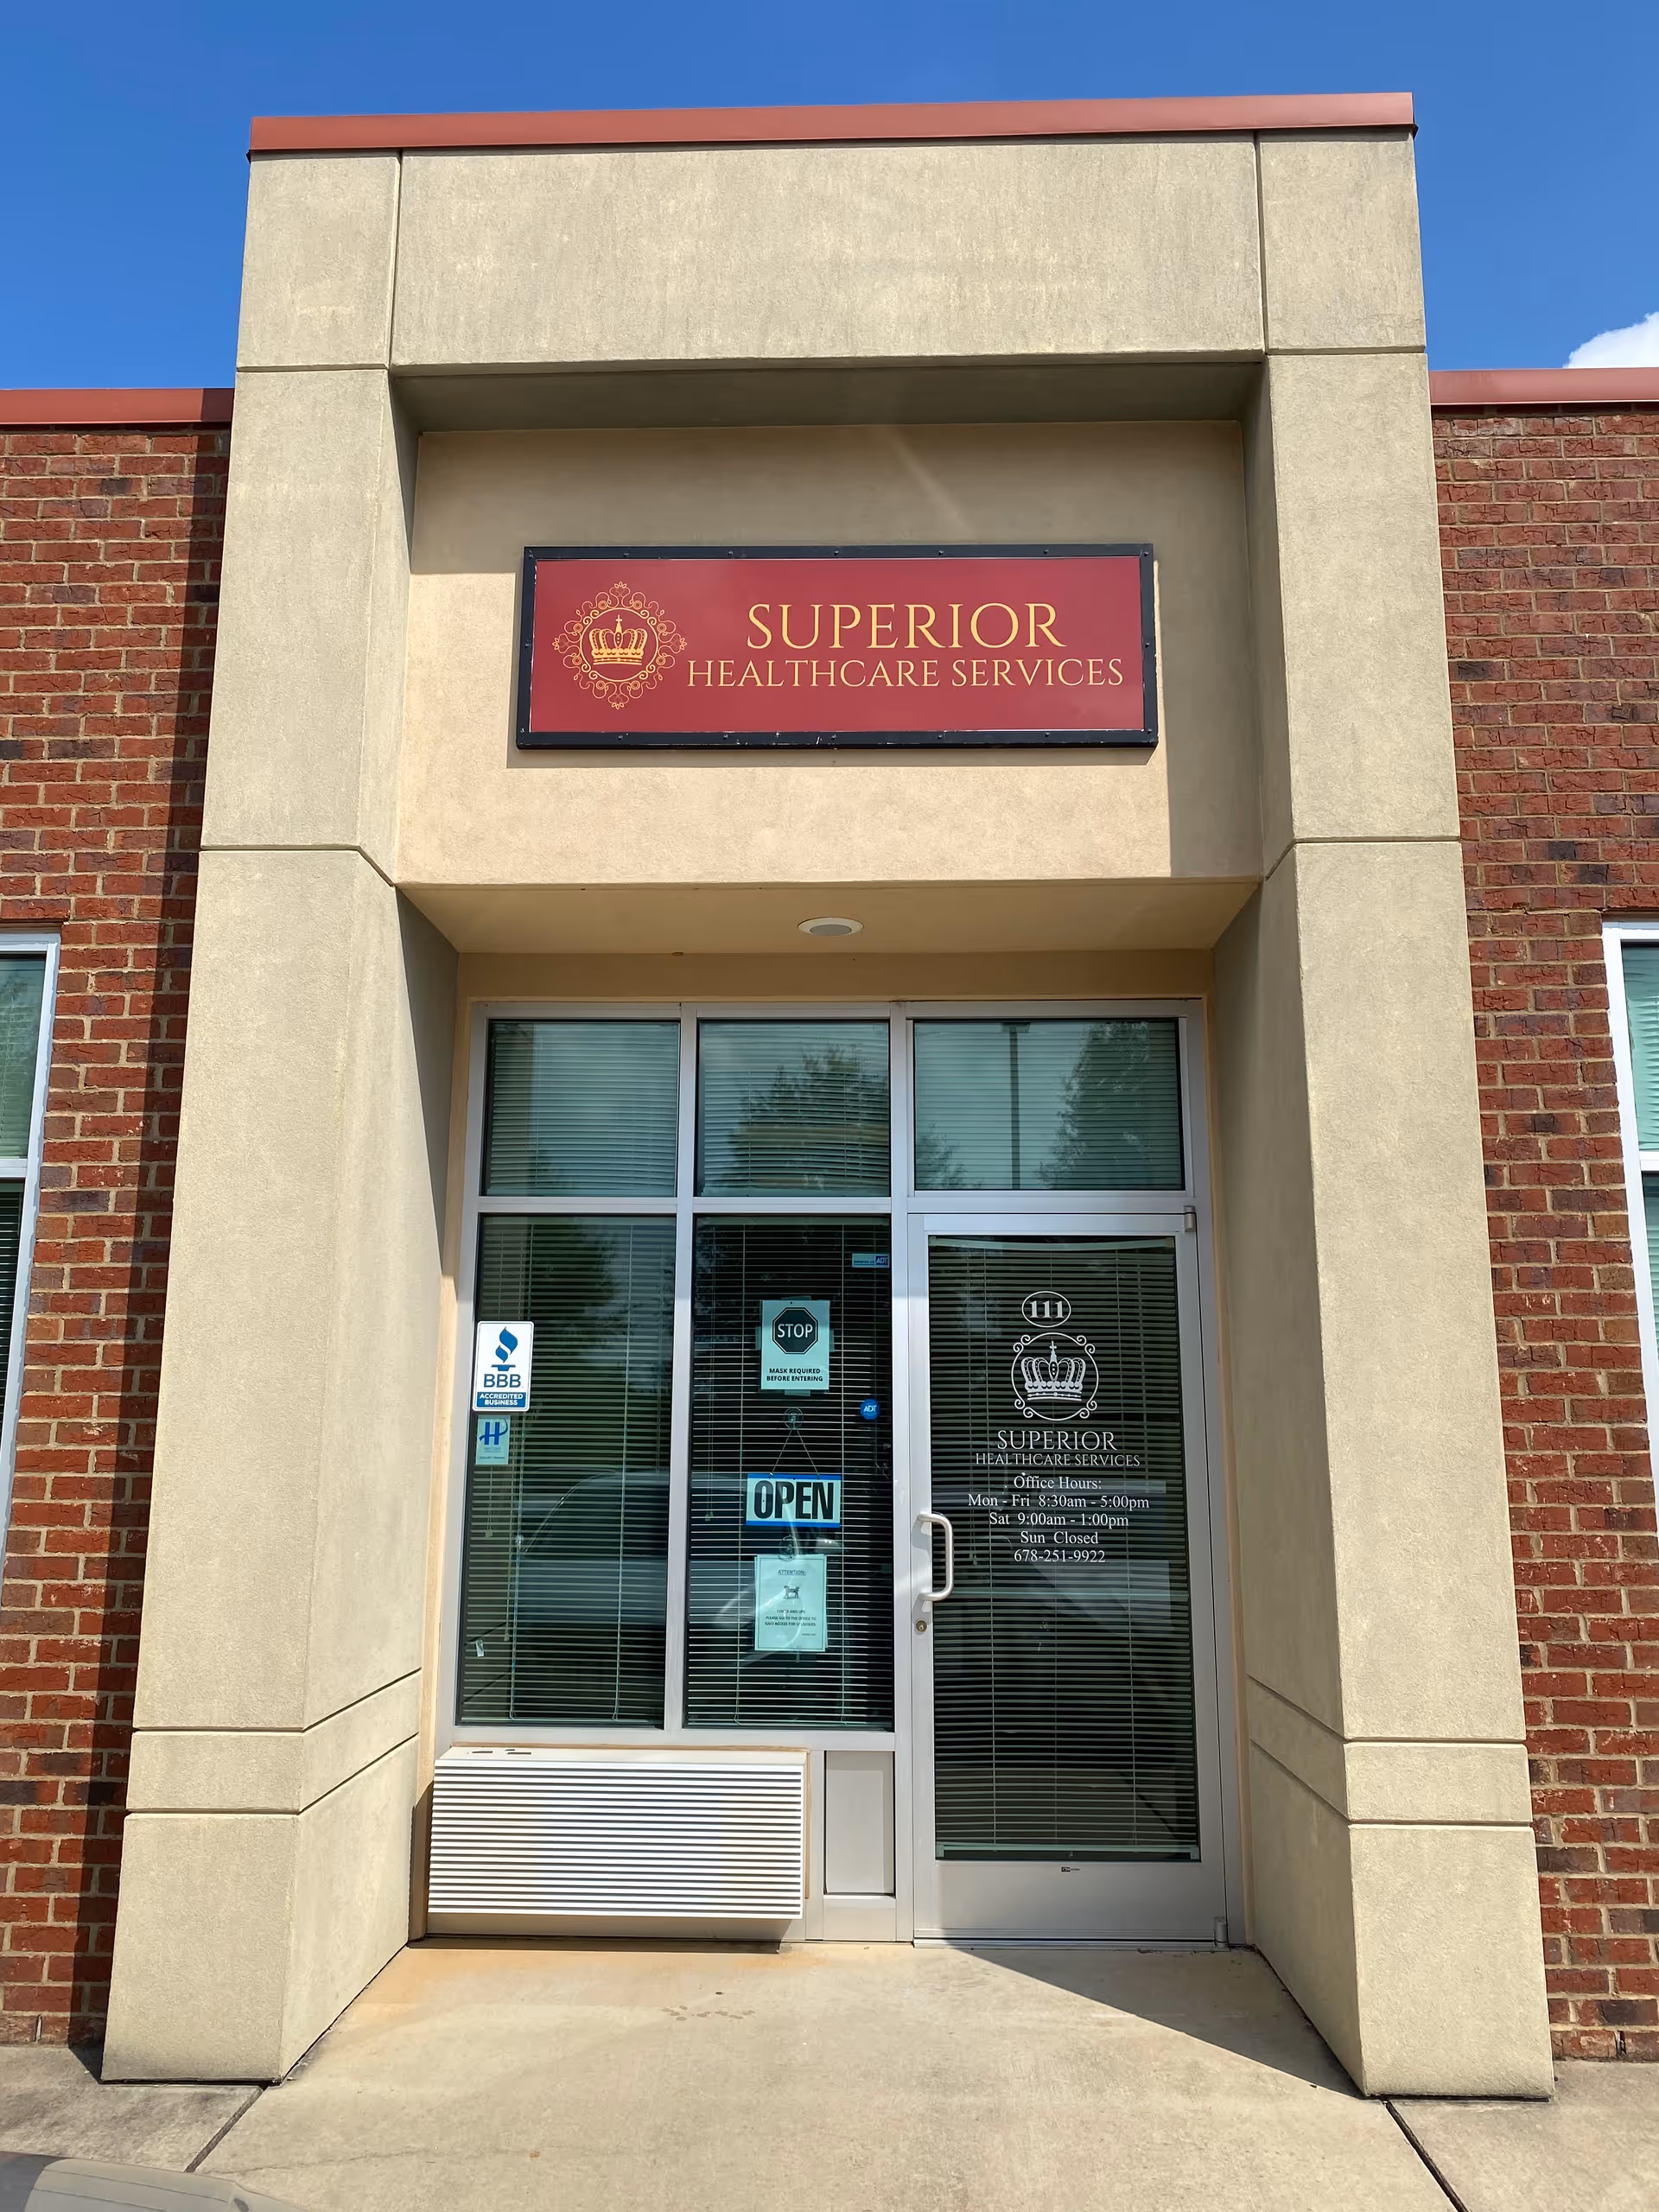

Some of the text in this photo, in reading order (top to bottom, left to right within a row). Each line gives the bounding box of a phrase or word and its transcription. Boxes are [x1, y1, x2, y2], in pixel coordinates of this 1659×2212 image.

[747, 602, 1066, 650] SUPERIOR
[687, 658, 1124, 689] HEALTHCARE SERVICES
[1029, 1300, 1065, 1319] 111
[777, 1323, 813, 1338] STOP
[484, 1373, 521, 1388] BBB
[863, 1404, 877, 1413] ADT
[997, 1430, 1118, 1451] SUPERIOR
[976, 1452, 1141, 1467] HEALTHCARE SERVICES
[1014, 1475, 1102, 1490] Office Hours:
[753, 1480, 834, 1520] OPEN
[968, 1493, 999, 1507] Mon
[1012, 1494, 1030, 1507] Fri
[1039, 1495, 1087, 1508] 8:30am
[1100, 1495, 1149, 1510] 5:00pm
[989, 1512, 1010, 1526] Sat
[1017, 1512, 1067, 1526] 9:00am
[1081, 1513, 1129, 1529] 1:00pm
[1020, 1531, 1099, 1545] Sun Closed
[1014, 1549, 1106, 1563] 678-251-9922
